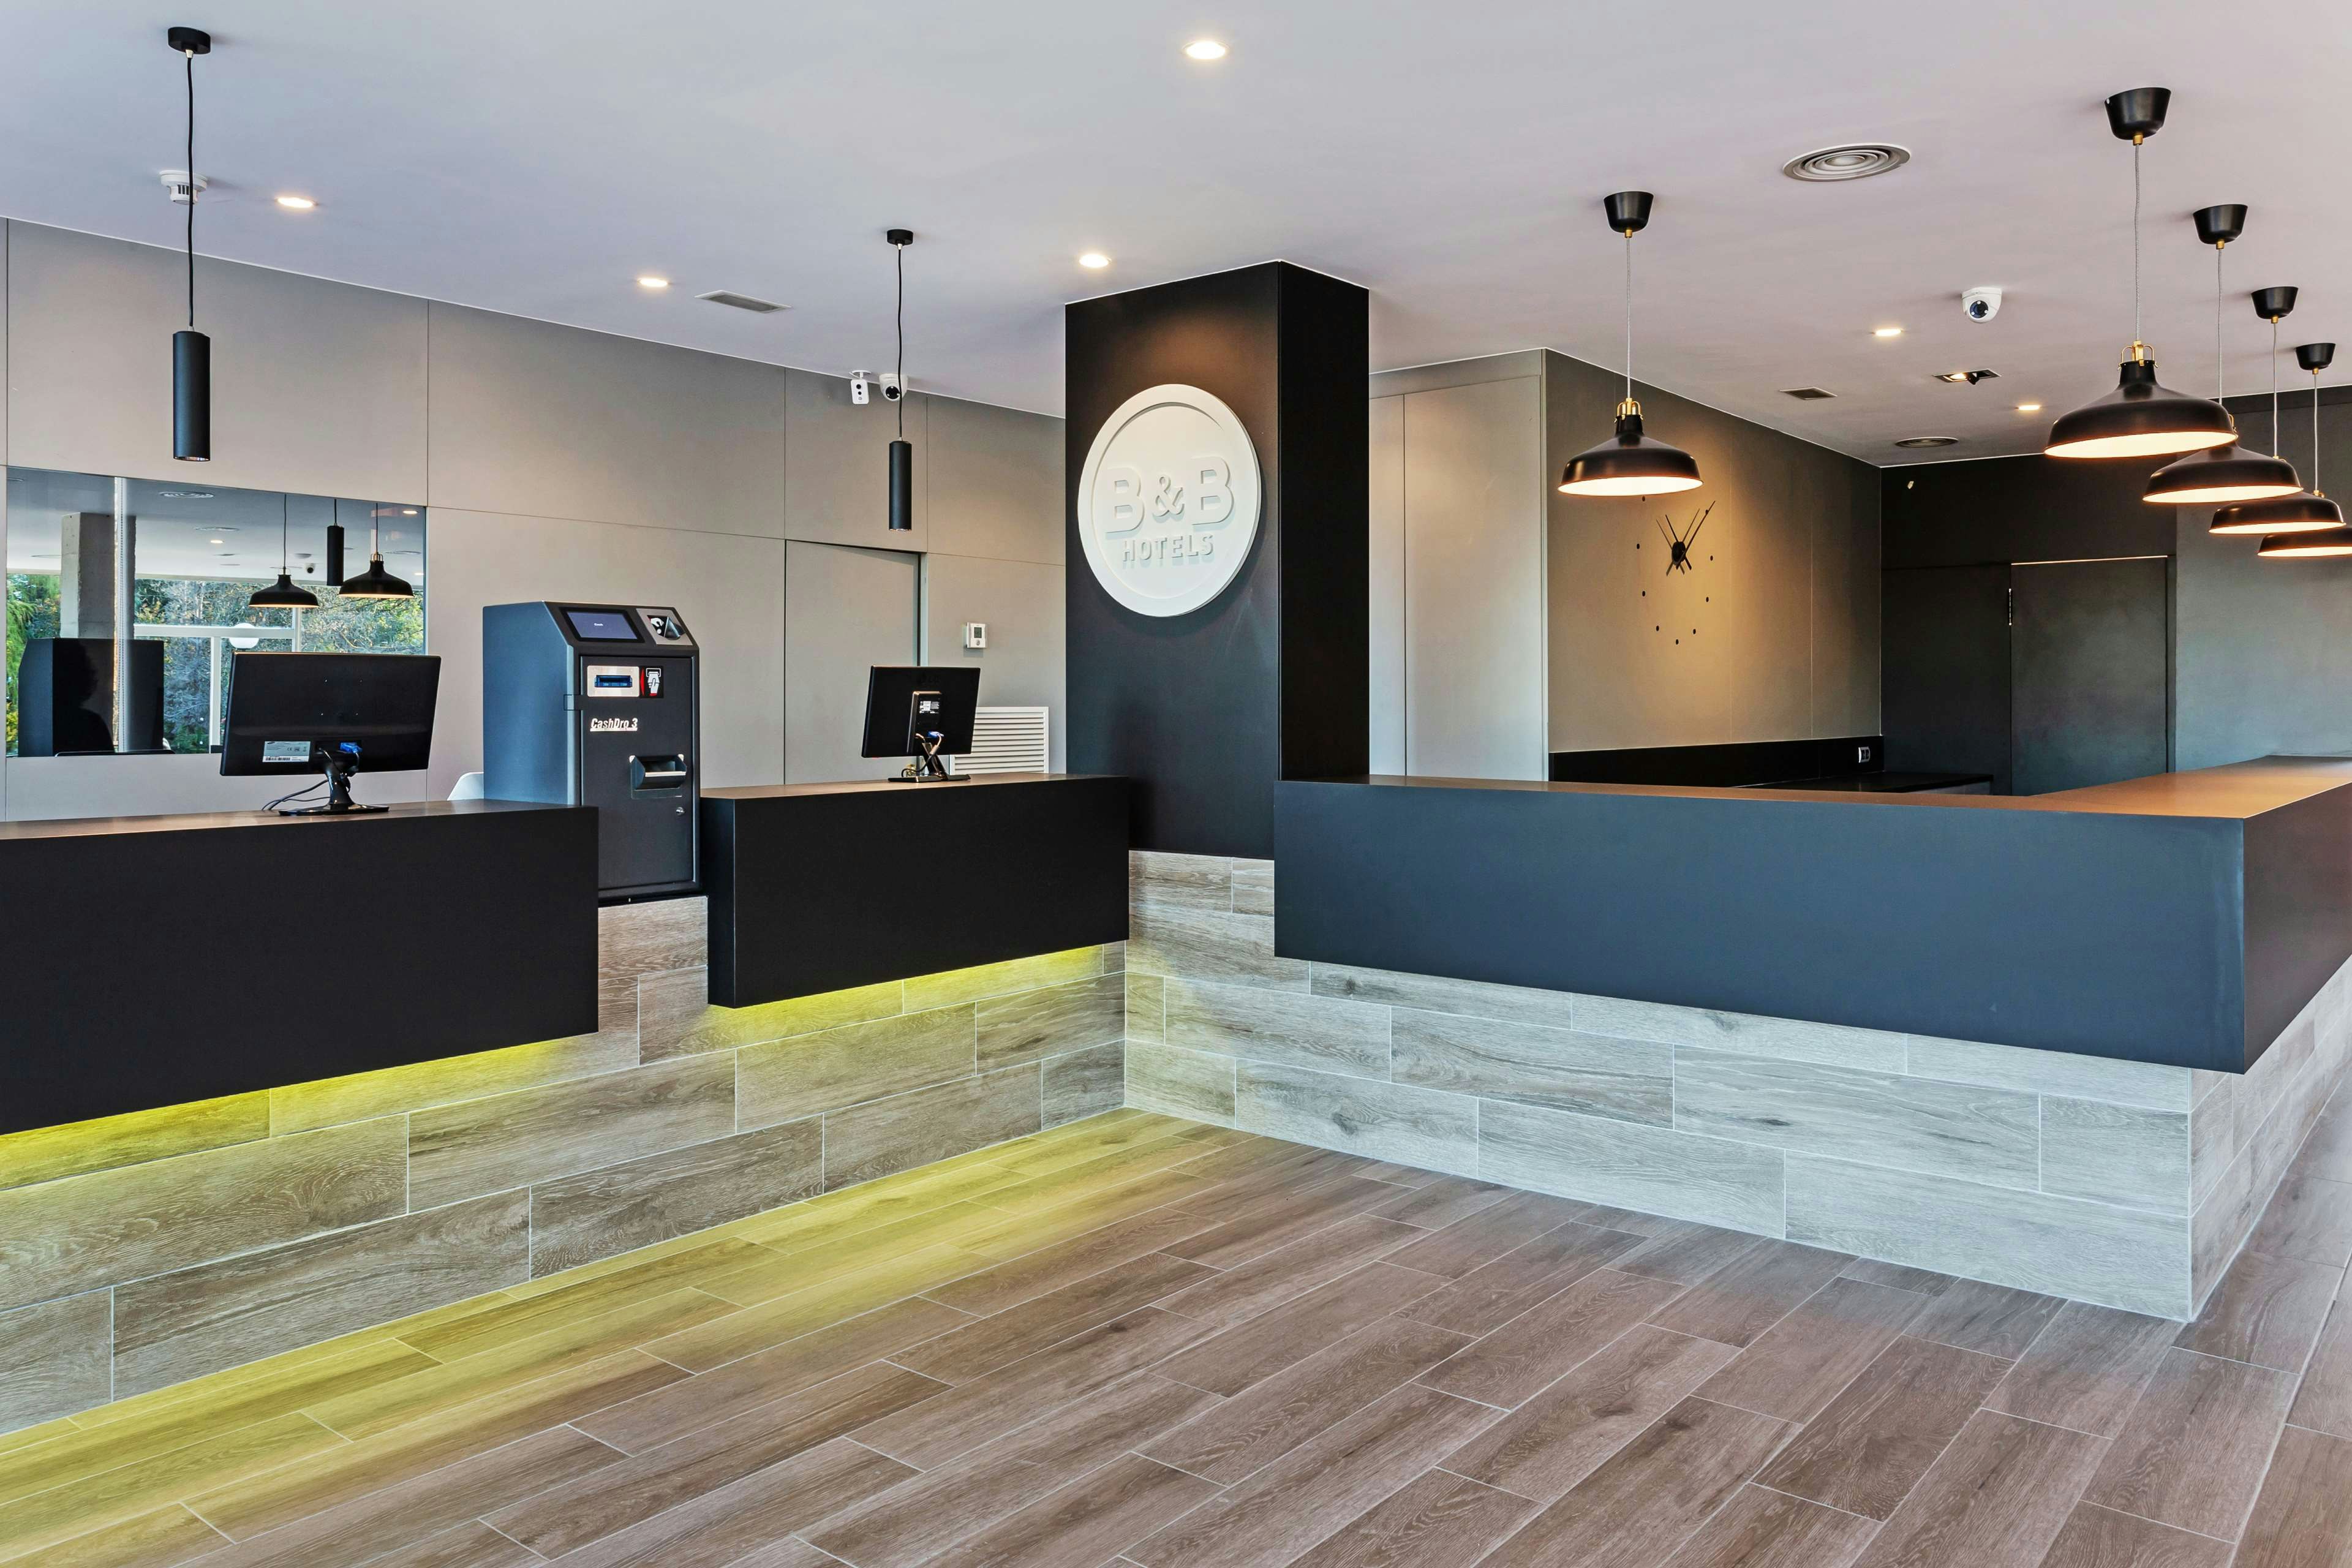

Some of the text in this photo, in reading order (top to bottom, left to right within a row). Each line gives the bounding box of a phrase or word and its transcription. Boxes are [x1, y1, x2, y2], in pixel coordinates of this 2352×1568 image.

[1105, 456, 1235, 533] B&B
[1122, 534, 1214, 562] HOTELS
[590, 717, 638, 728] CashDro 3
